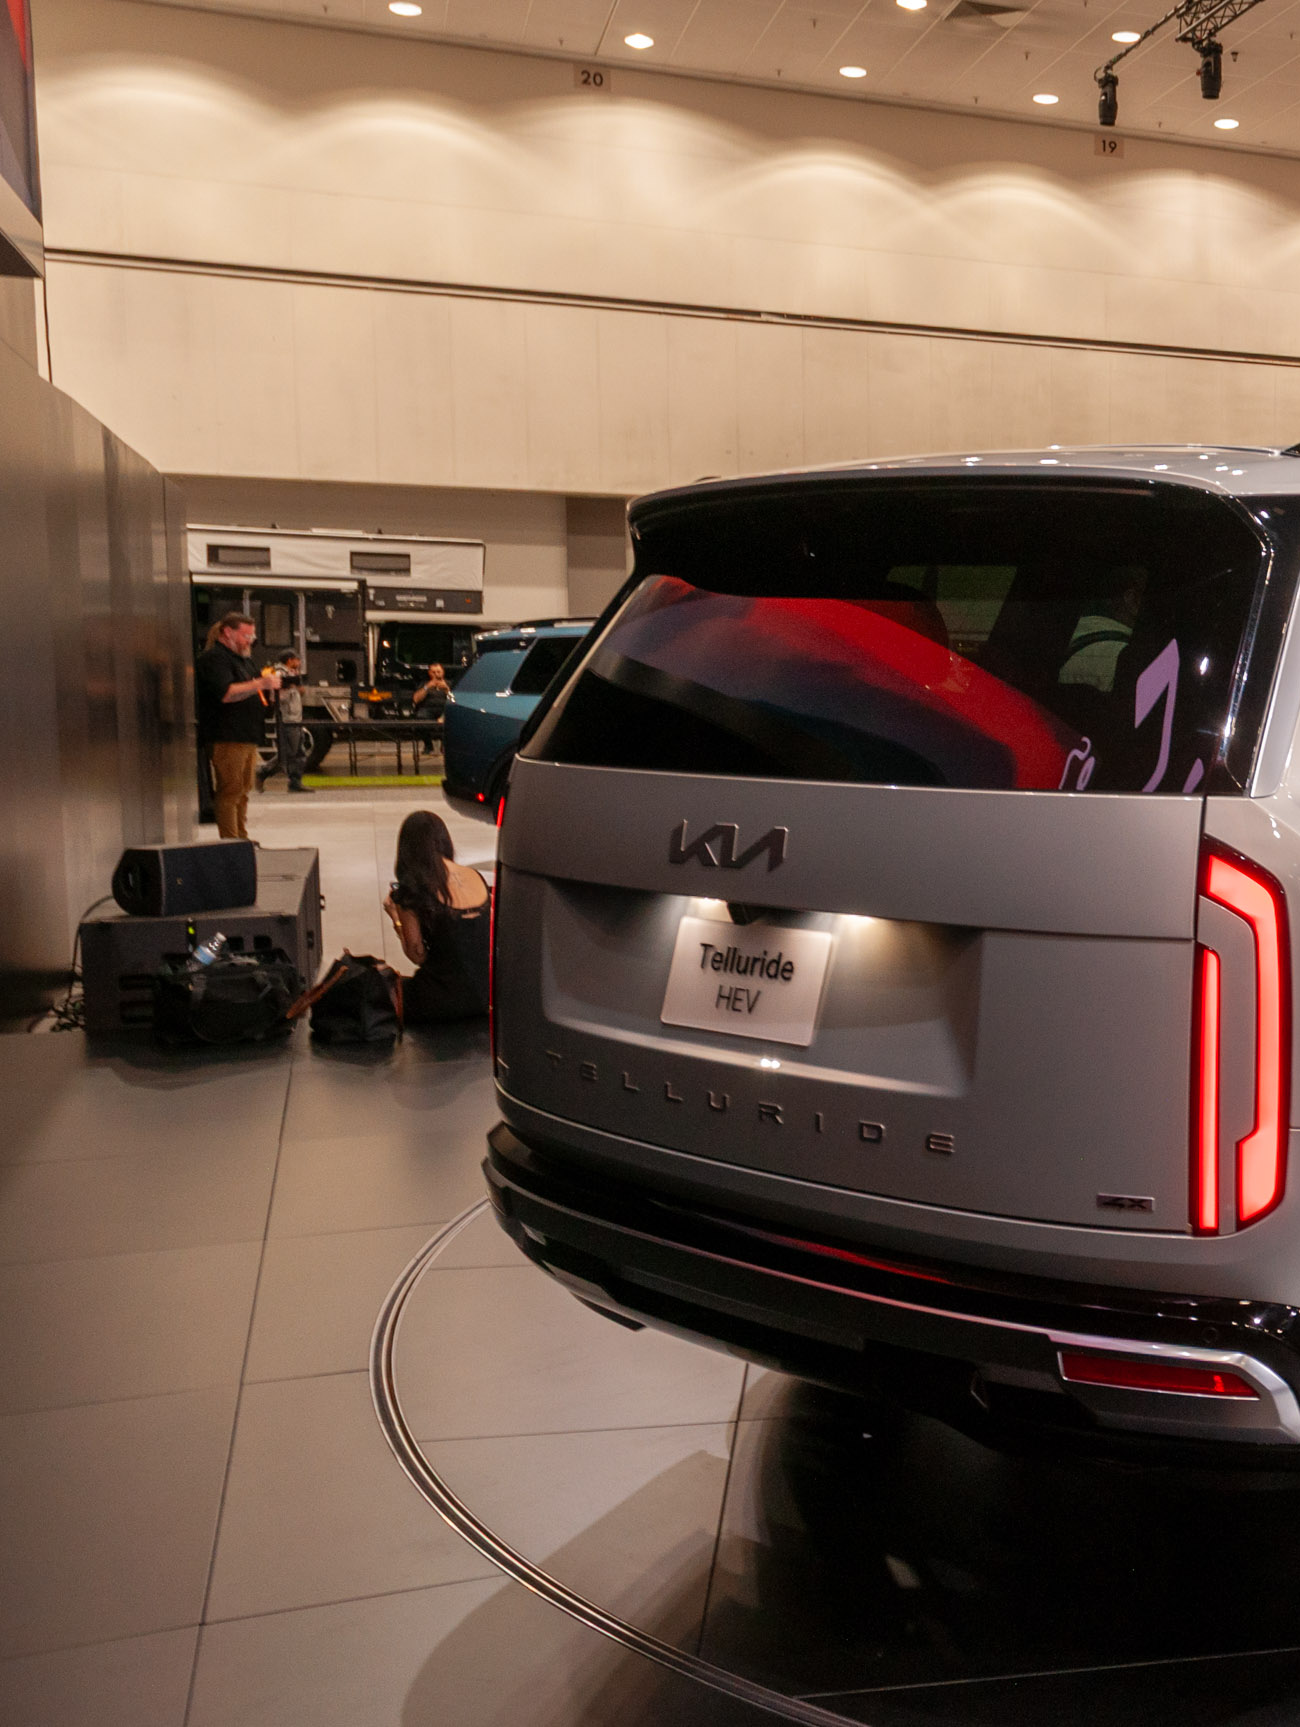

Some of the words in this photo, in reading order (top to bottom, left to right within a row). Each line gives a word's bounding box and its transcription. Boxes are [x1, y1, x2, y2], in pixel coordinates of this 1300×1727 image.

[581, 69, 604, 87] 20
[1102, 139, 1117, 154] 19
[669, 818, 790, 873] KIA
[699, 942, 796, 983] Telluride
[714, 983, 762, 1014] HEV
[545, 1049, 957, 1155] TELLURIDE
